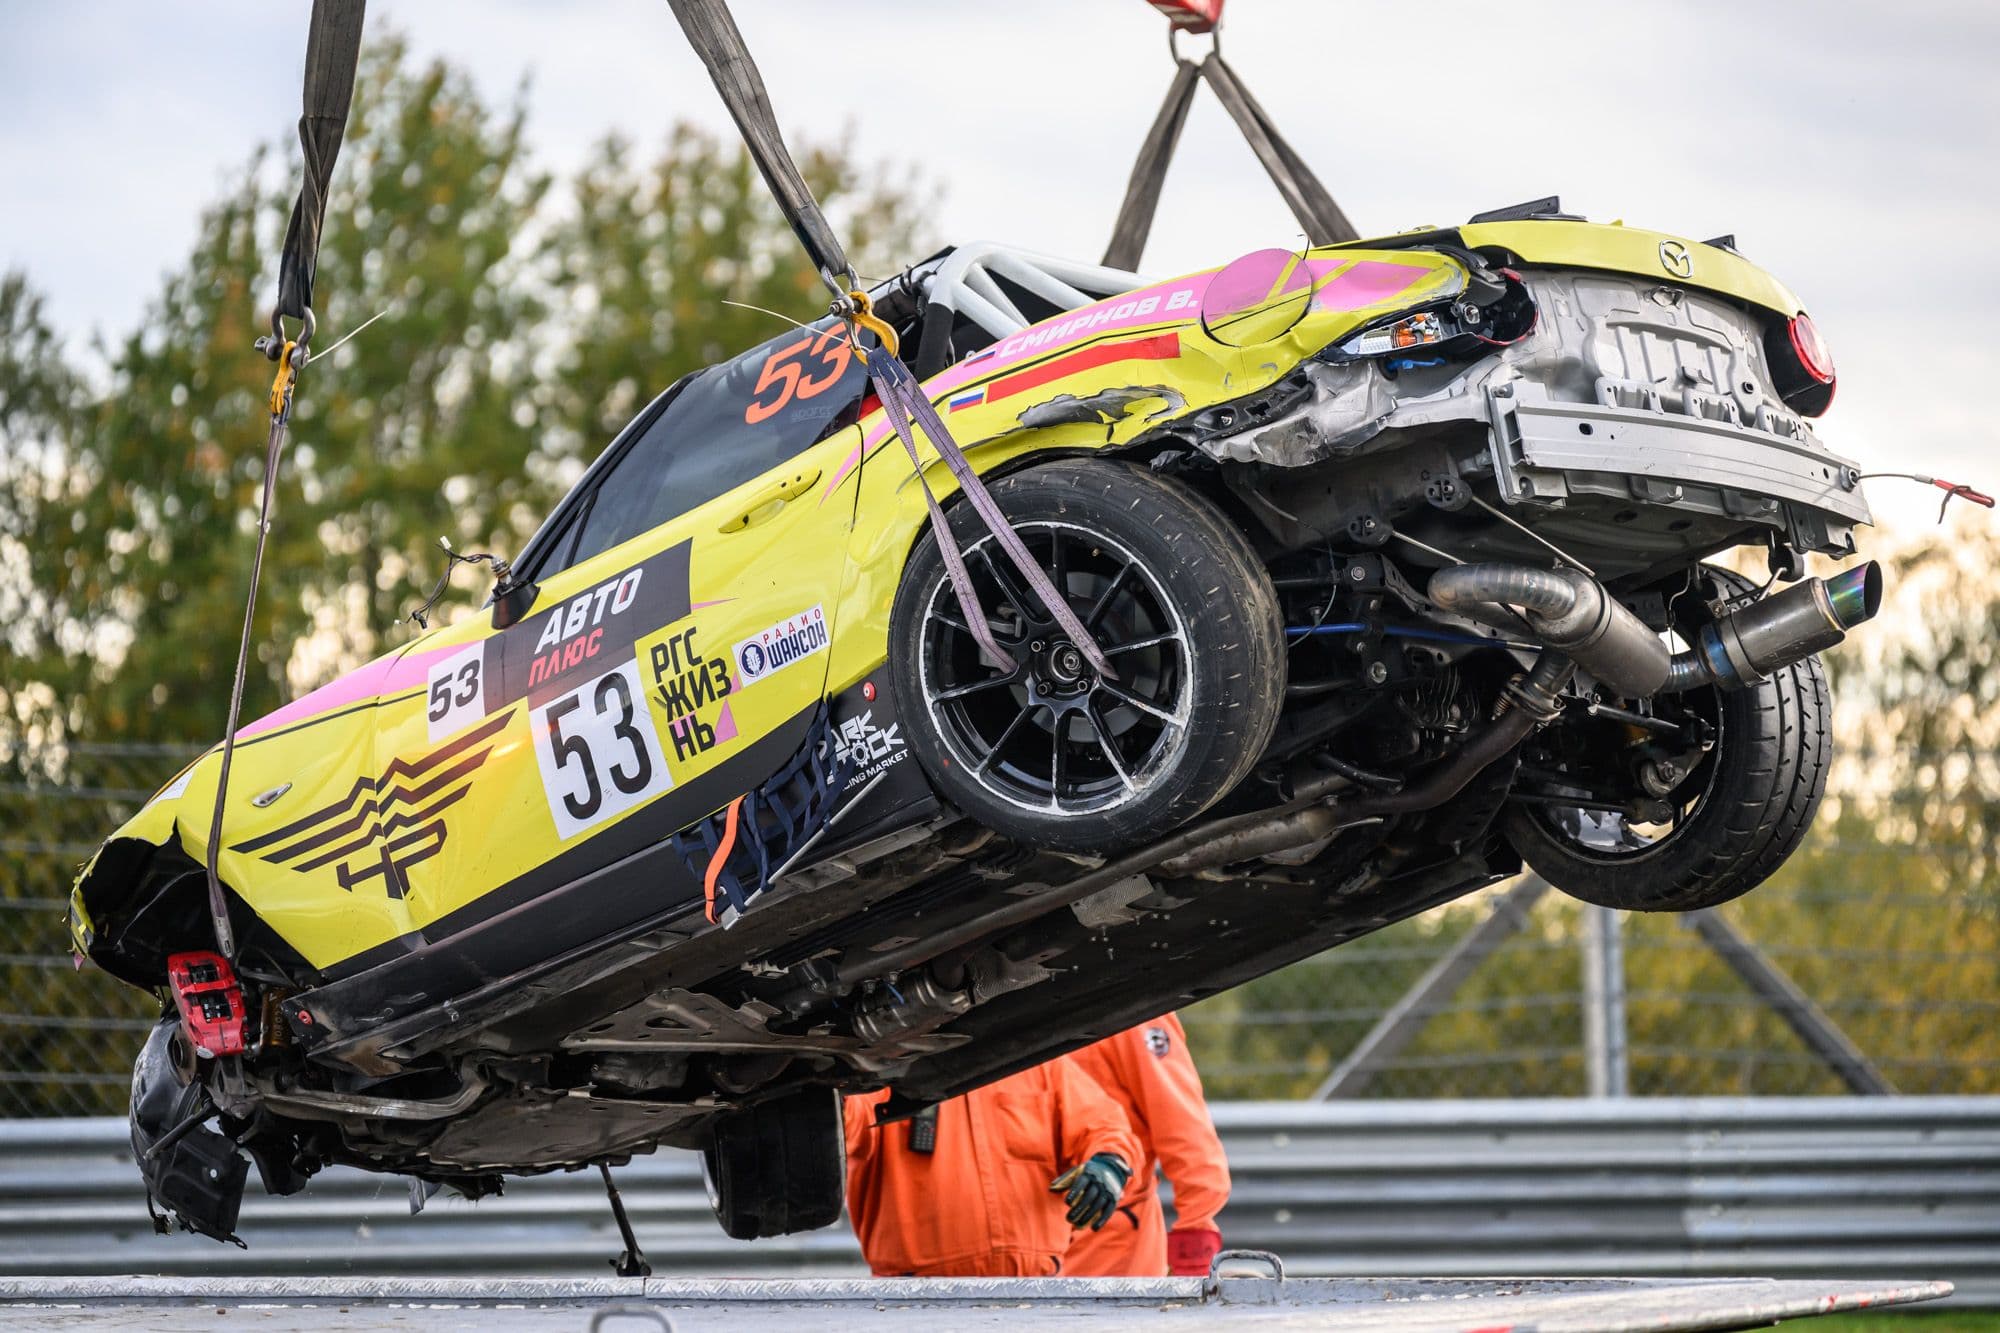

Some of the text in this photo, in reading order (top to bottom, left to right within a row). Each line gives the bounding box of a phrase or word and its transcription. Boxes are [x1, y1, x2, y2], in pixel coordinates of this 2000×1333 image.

[999, 295, 1162, 359] СМИРНОВ
[744, 321, 863, 426] 53
[533, 567, 644, 656] АВТО
[762, 607, 822, 645] РАДИО
[526, 627, 604, 689] ПЛЮС
[650, 626, 703, 684] РГС
[766, 619, 828, 670] ШАНСОН
[428, 658, 481, 723] 53
[655, 657, 733, 724] ЖИЗ
[545, 671, 653, 821] 53
[668, 713, 717, 763] НЬ
[866, 748, 909, 777] MARKET
